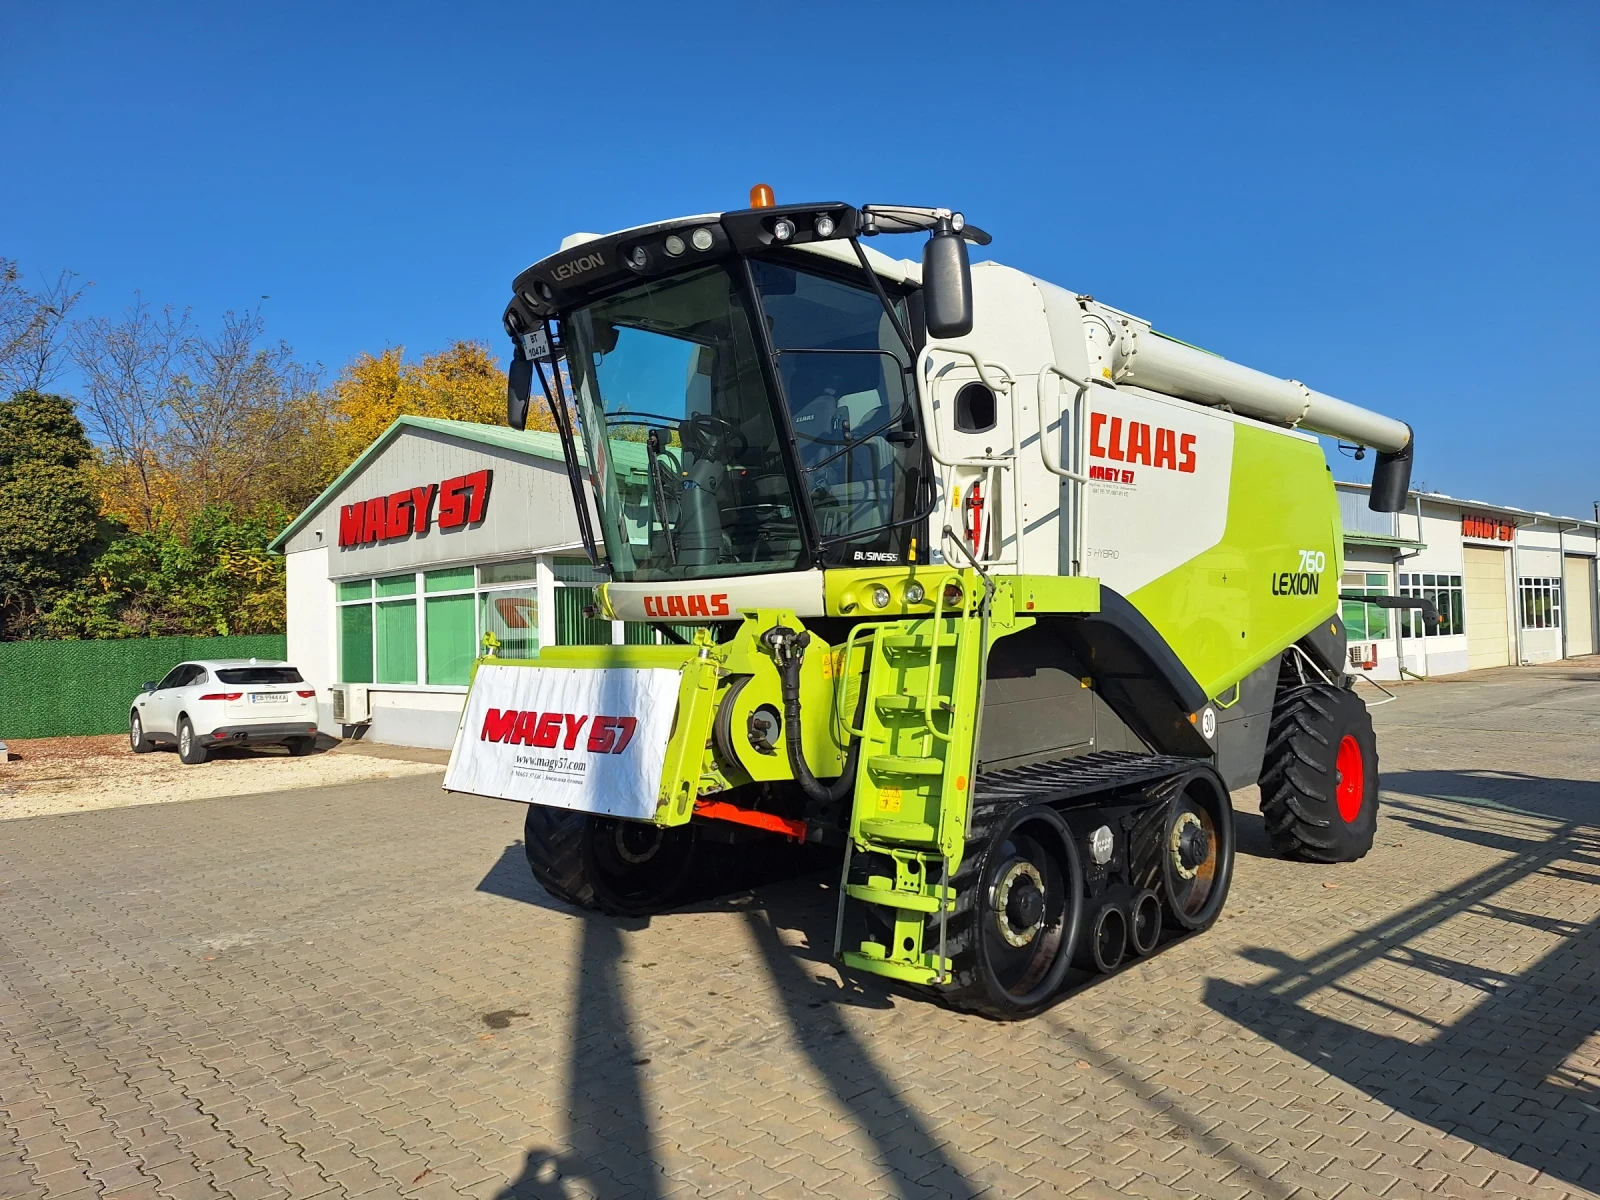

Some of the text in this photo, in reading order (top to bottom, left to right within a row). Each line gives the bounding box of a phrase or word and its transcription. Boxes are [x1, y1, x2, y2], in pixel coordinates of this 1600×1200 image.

[550, 252, 606, 282] LEXION
[530, 333, 538, 344] BT
[796, 414, 815, 423] CLAAS
[1089, 411, 1197, 474] CLAAS
[1089, 465, 1135, 484] MAGY 57
[338, 469, 493, 548] MAGY 57
[853, 551, 899, 562] BUSINESS
[1298, 549, 1326, 573] 760
[1272, 572, 1320, 596] LEXION
[643, 593, 730, 617] CLAAS
[480, 708, 638, 755] MAGY 57
[1204, 713, 1214, 733] 30
[516, 755, 587, 772] www.magy57.com
